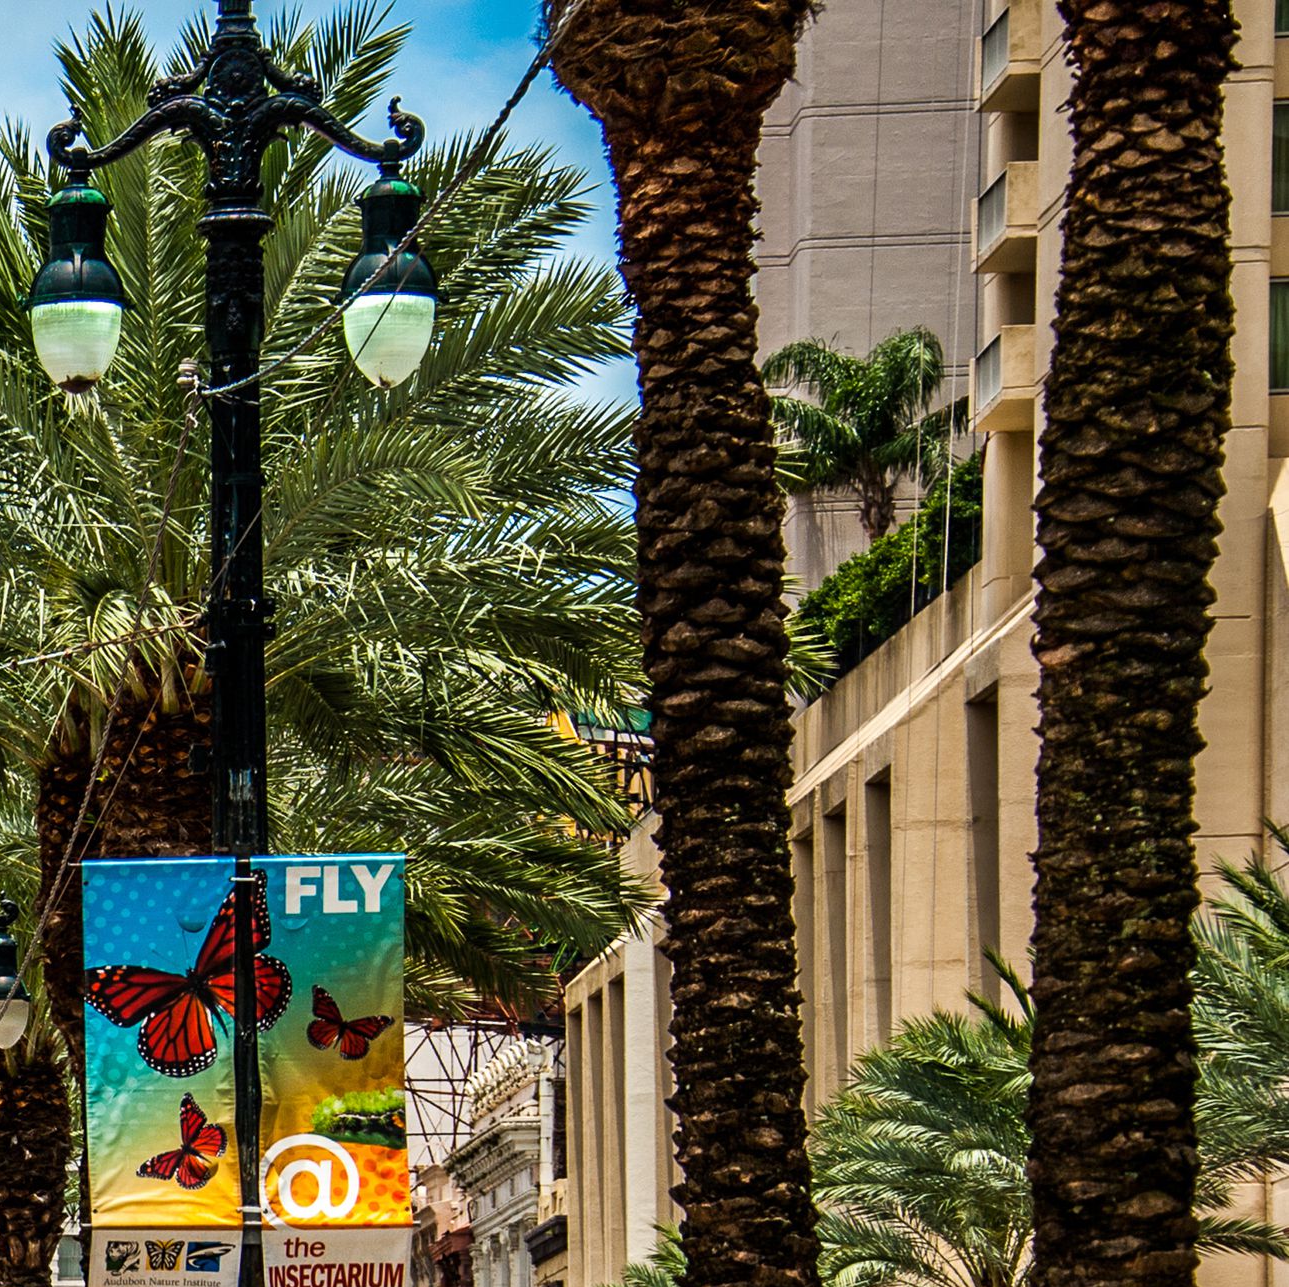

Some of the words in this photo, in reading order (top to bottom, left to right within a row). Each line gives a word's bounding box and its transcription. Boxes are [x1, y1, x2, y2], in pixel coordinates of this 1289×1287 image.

[284, 864, 395, 915] FLY
[284, 1237, 326, 1258] the
[104, 1277, 146, 1286] Audubon
[149, 1277, 180, 1286] Nature
[183, 1279, 221, 1287] Institute
